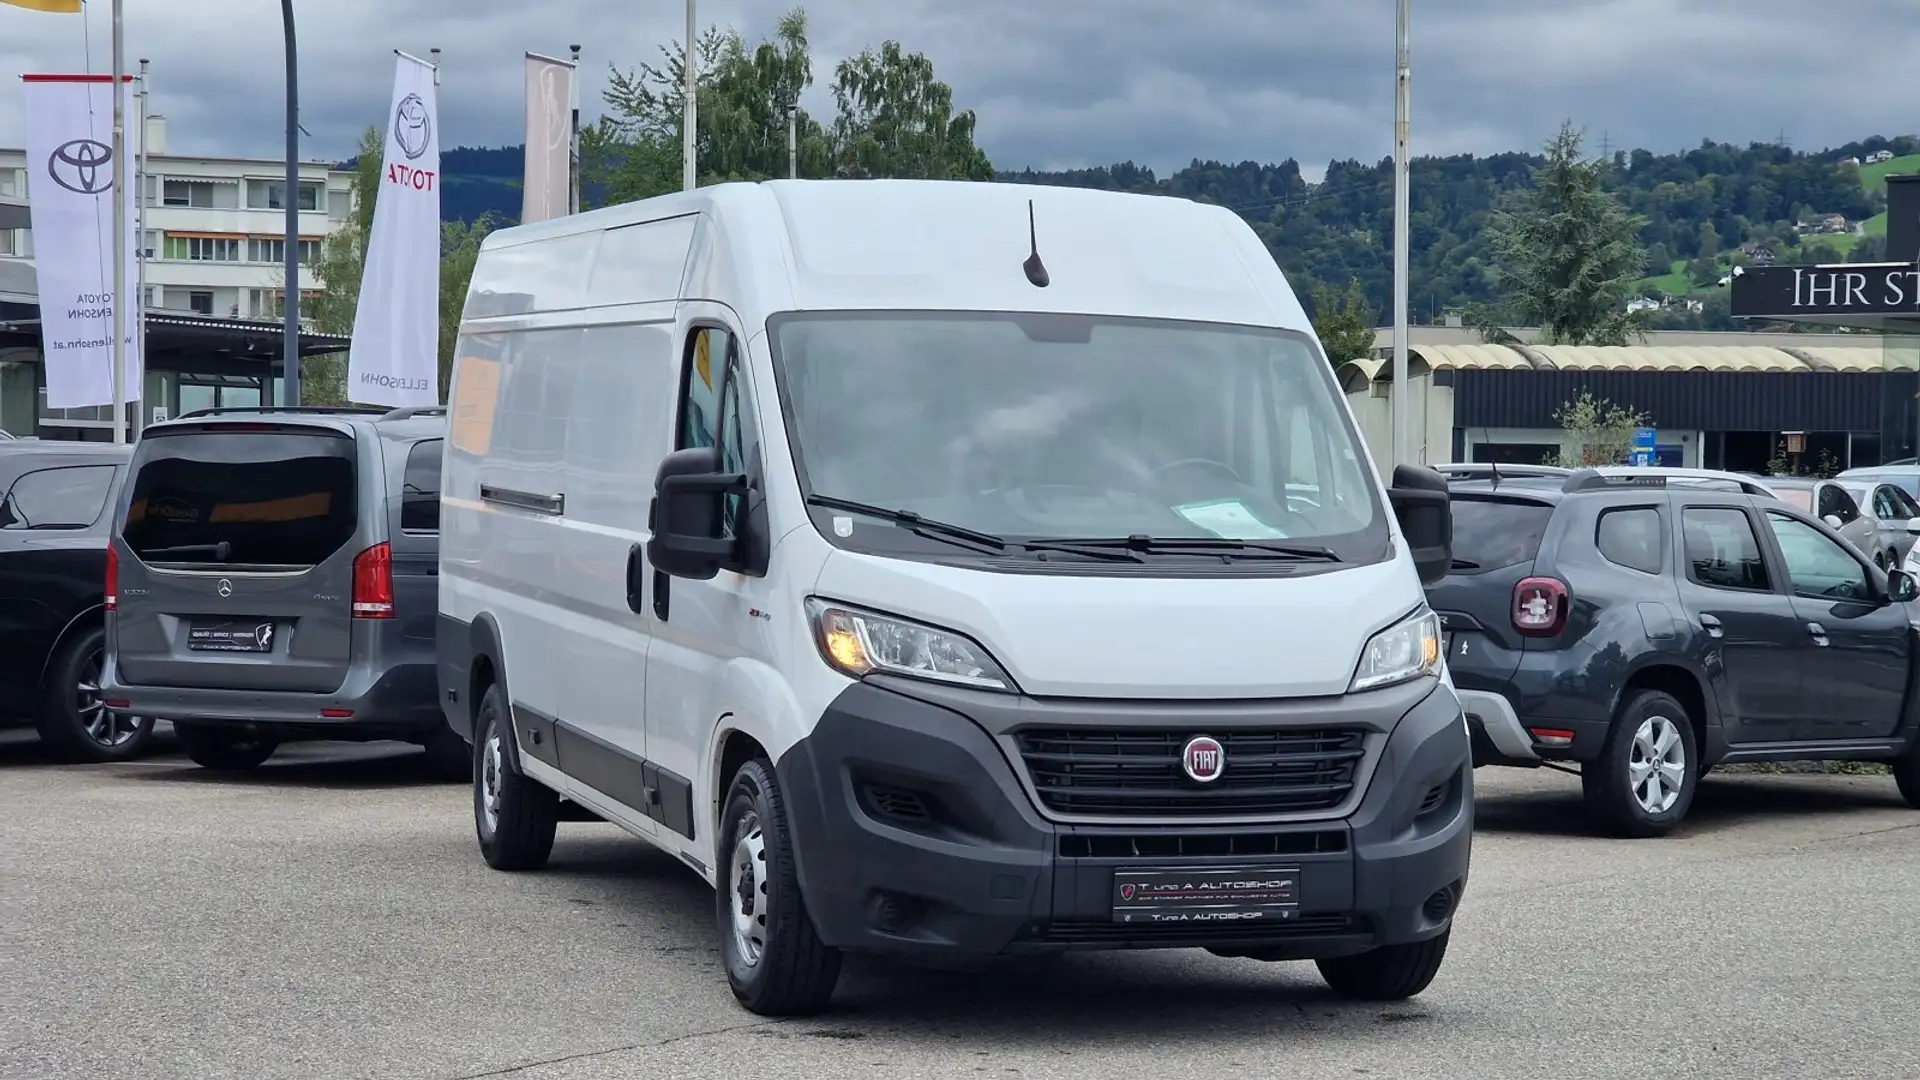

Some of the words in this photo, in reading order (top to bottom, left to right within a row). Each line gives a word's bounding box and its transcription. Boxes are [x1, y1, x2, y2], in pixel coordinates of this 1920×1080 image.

[1791, 268, 1871, 306] IHR
[1193, 750, 1217, 770] FIAT
[1183, 882, 1194, 890] A
[1199, 880, 1292, 890] AUTOSHOP
[1193, 911, 1263, 920] AUTOSHOP
